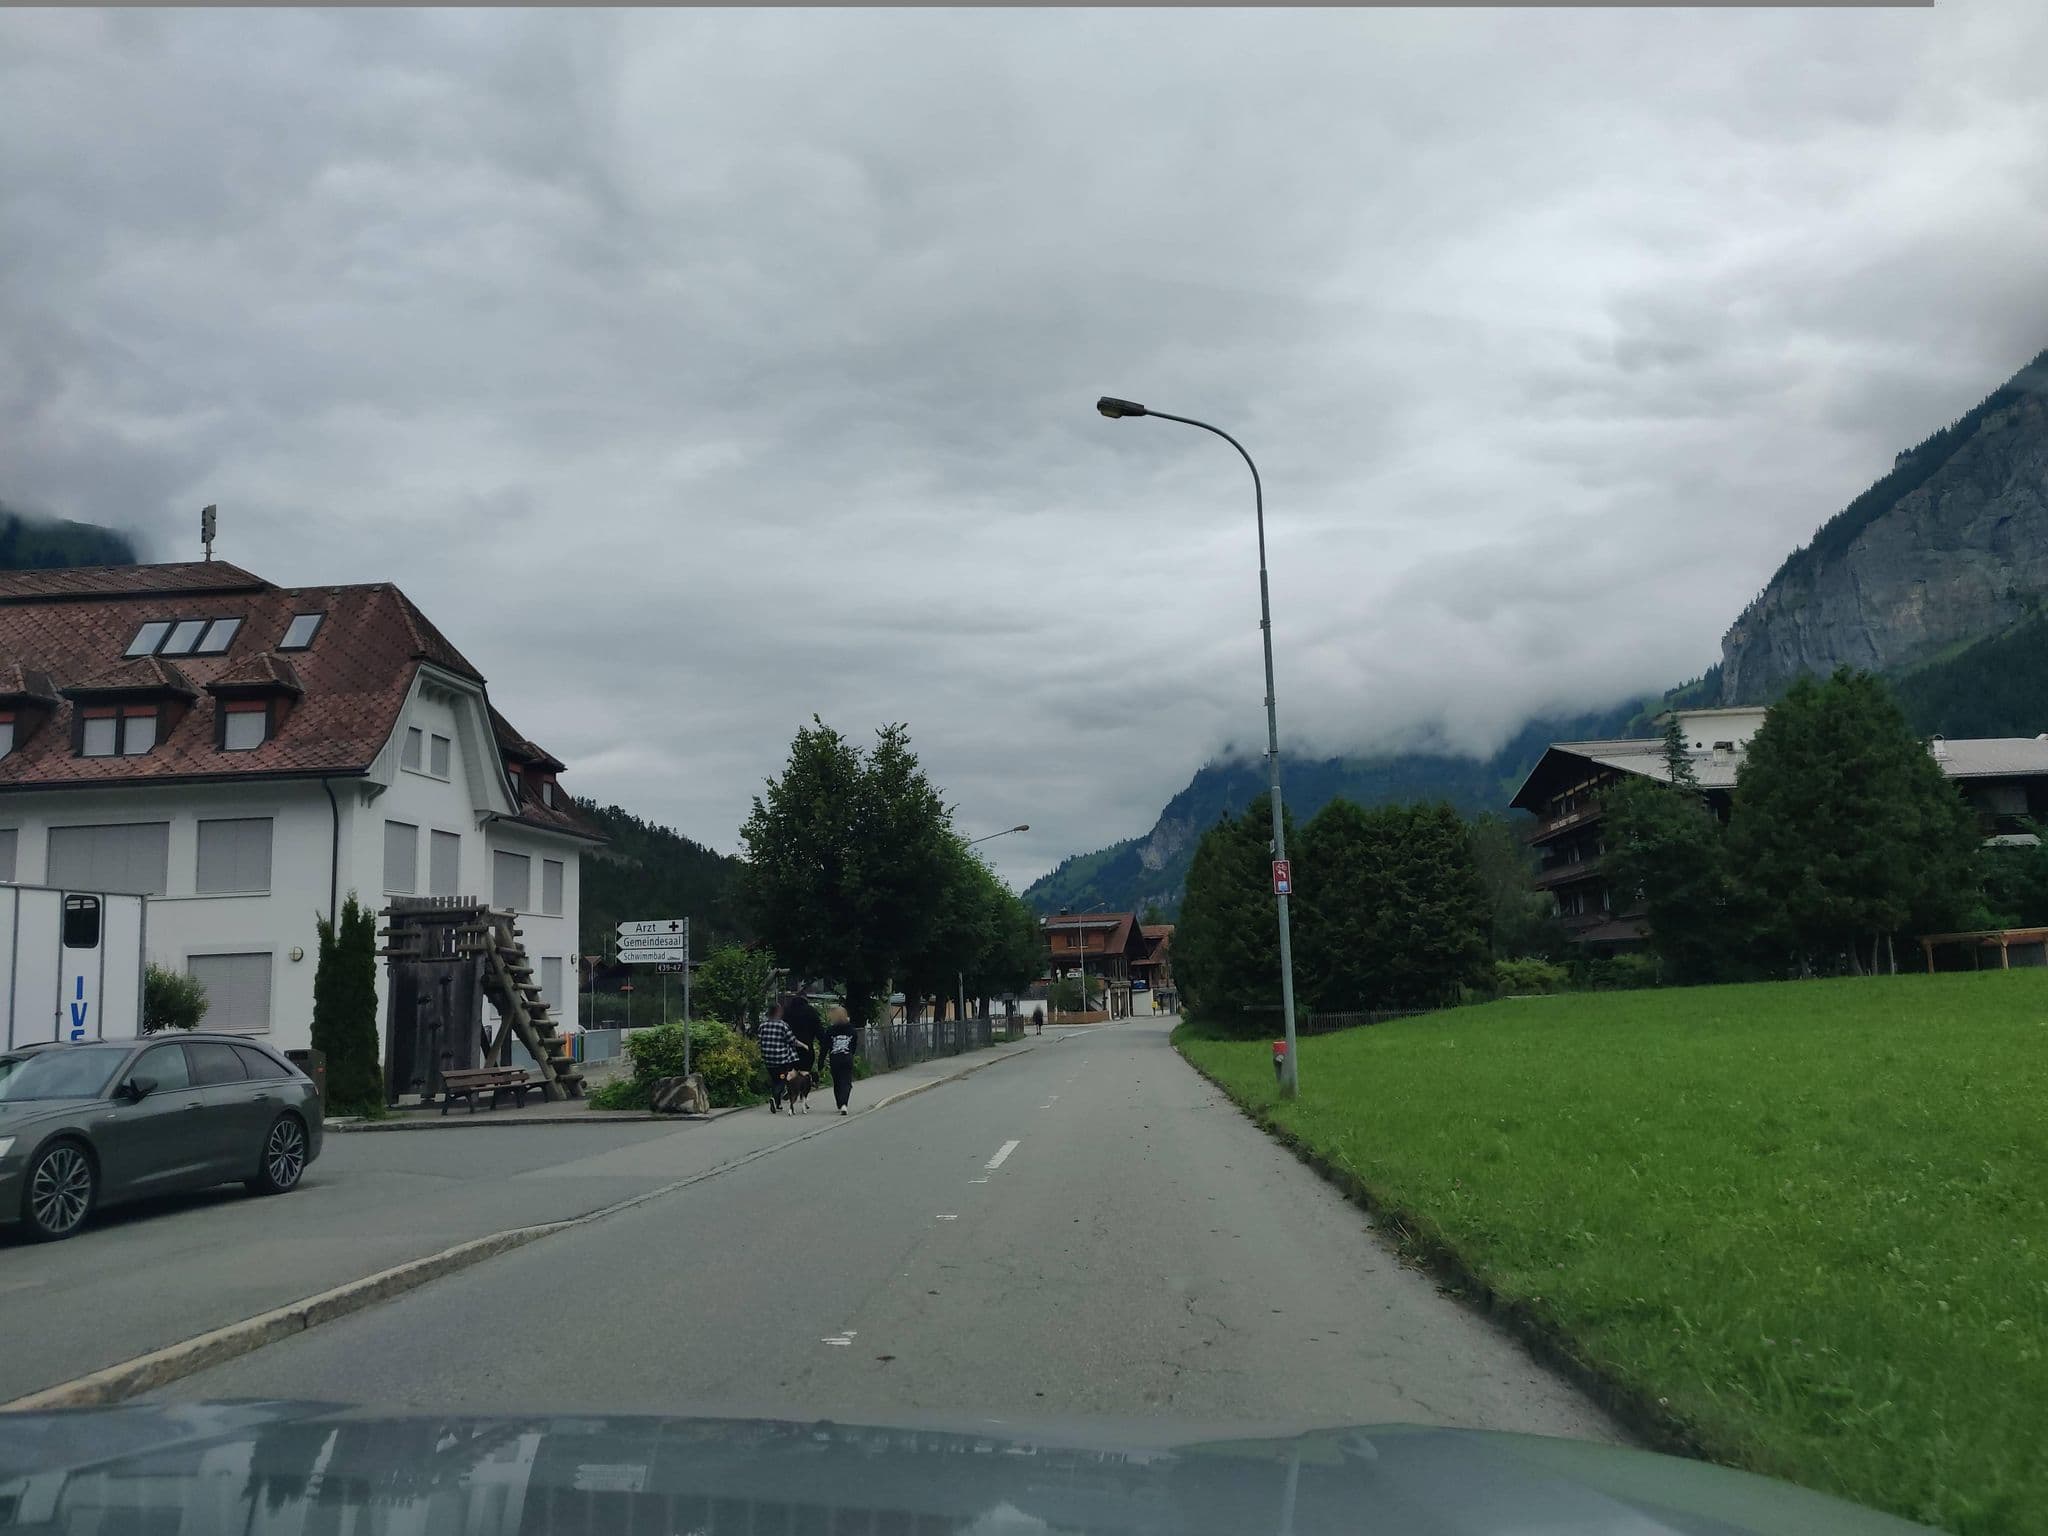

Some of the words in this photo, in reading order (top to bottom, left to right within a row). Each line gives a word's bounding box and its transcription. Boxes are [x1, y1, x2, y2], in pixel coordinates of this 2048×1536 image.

[635, 923, 656, 933] Arzt
[623, 936, 681, 947] Gemeindesaal
[623, 951, 666, 961] Schwimmbad
